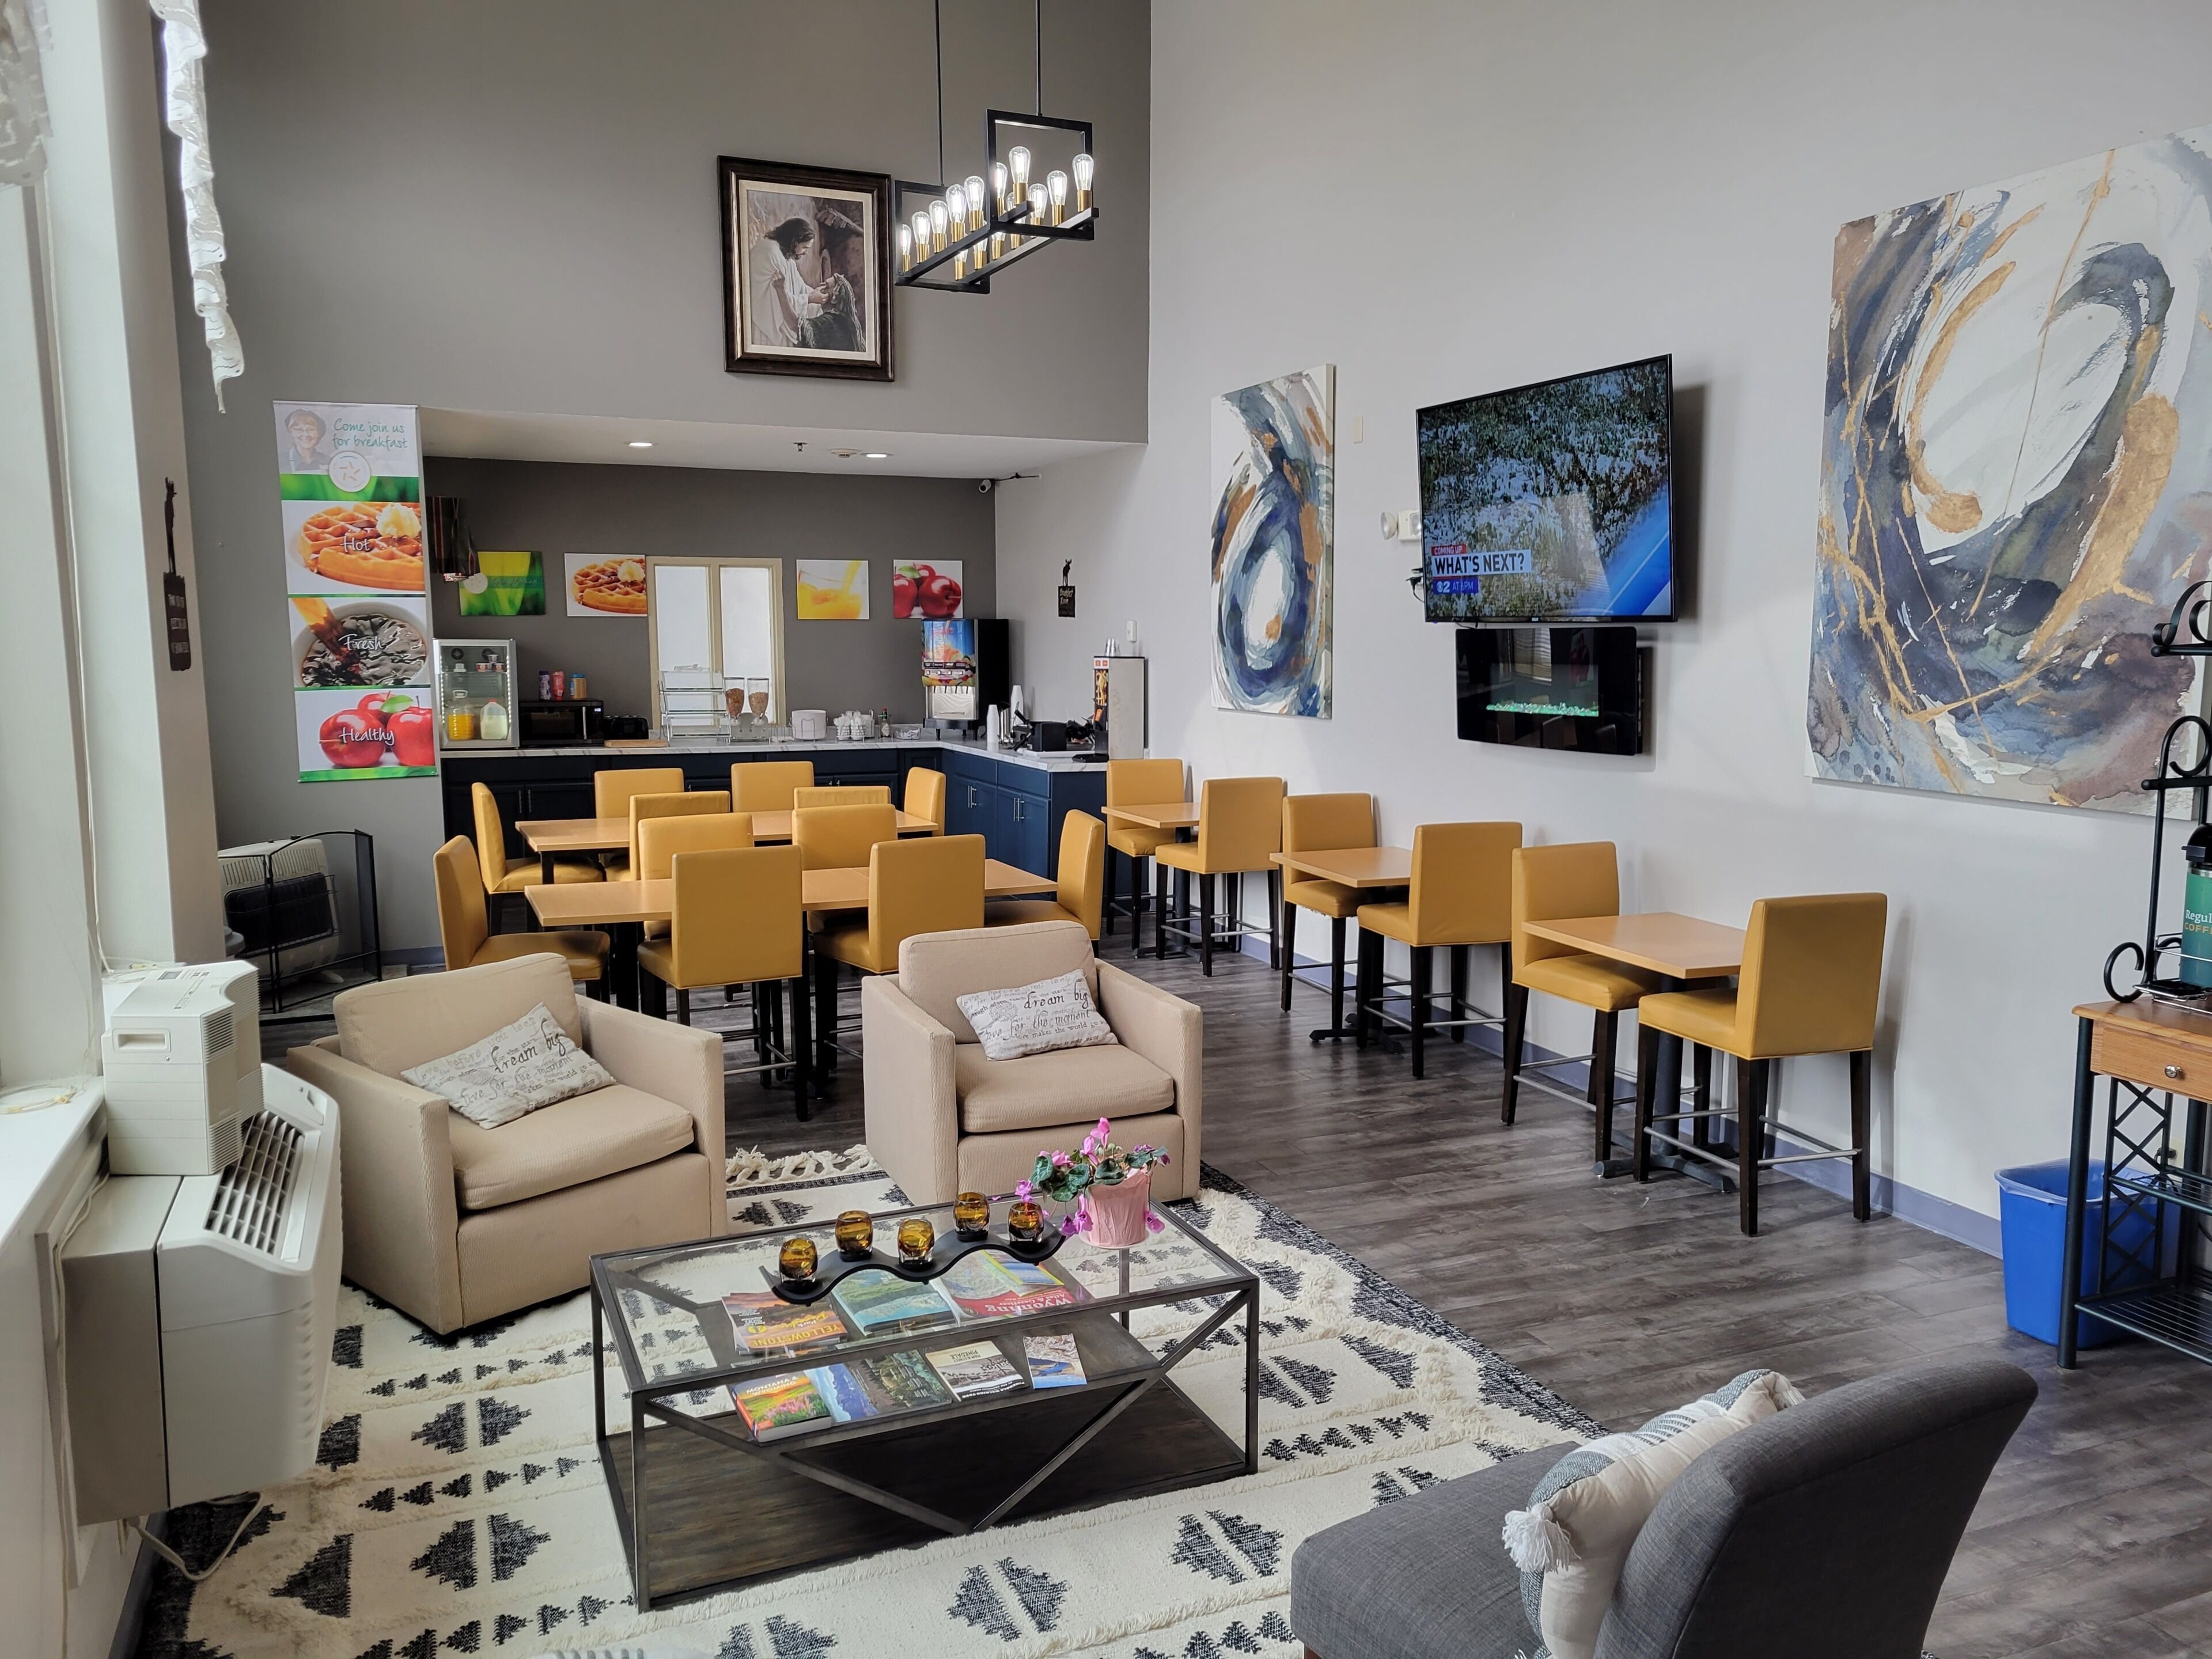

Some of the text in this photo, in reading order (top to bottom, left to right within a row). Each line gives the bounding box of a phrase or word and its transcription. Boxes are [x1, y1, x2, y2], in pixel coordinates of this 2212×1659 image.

[334, 418, 404, 437] Come join us
[332, 433, 408, 452] for breakfast
[340, 534, 370, 552] Hot
[1434, 546, 1463, 555] COMING UP
[1434, 552, 1524, 574] WHAT'S NEXT?
[1452, 581, 1460, 591] AT
[1460, 581, 1474, 591] 6PM
[338, 634, 383, 650] Fresh
[339, 727, 395, 747] Healthy
[1024, 991, 1065, 1009] dream
[1074, 979, 1089, 1009] big
[1055, 1010, 1090, 1024] moment
[1032, 1029, 1052, 1038] makes
[1067, 1021, 1088, 1031] world
[491, 1046, 539, 1073] dream
[541, 1018, 567, 1056] big
[984, 1297, 1071, 1316] Wyoming
[752, 1324, 840, 1346] YELLOWSTONE
[746, 1378, 790, 1394] MONTANA
[752, 1381, 797, 1396] WYOMING
